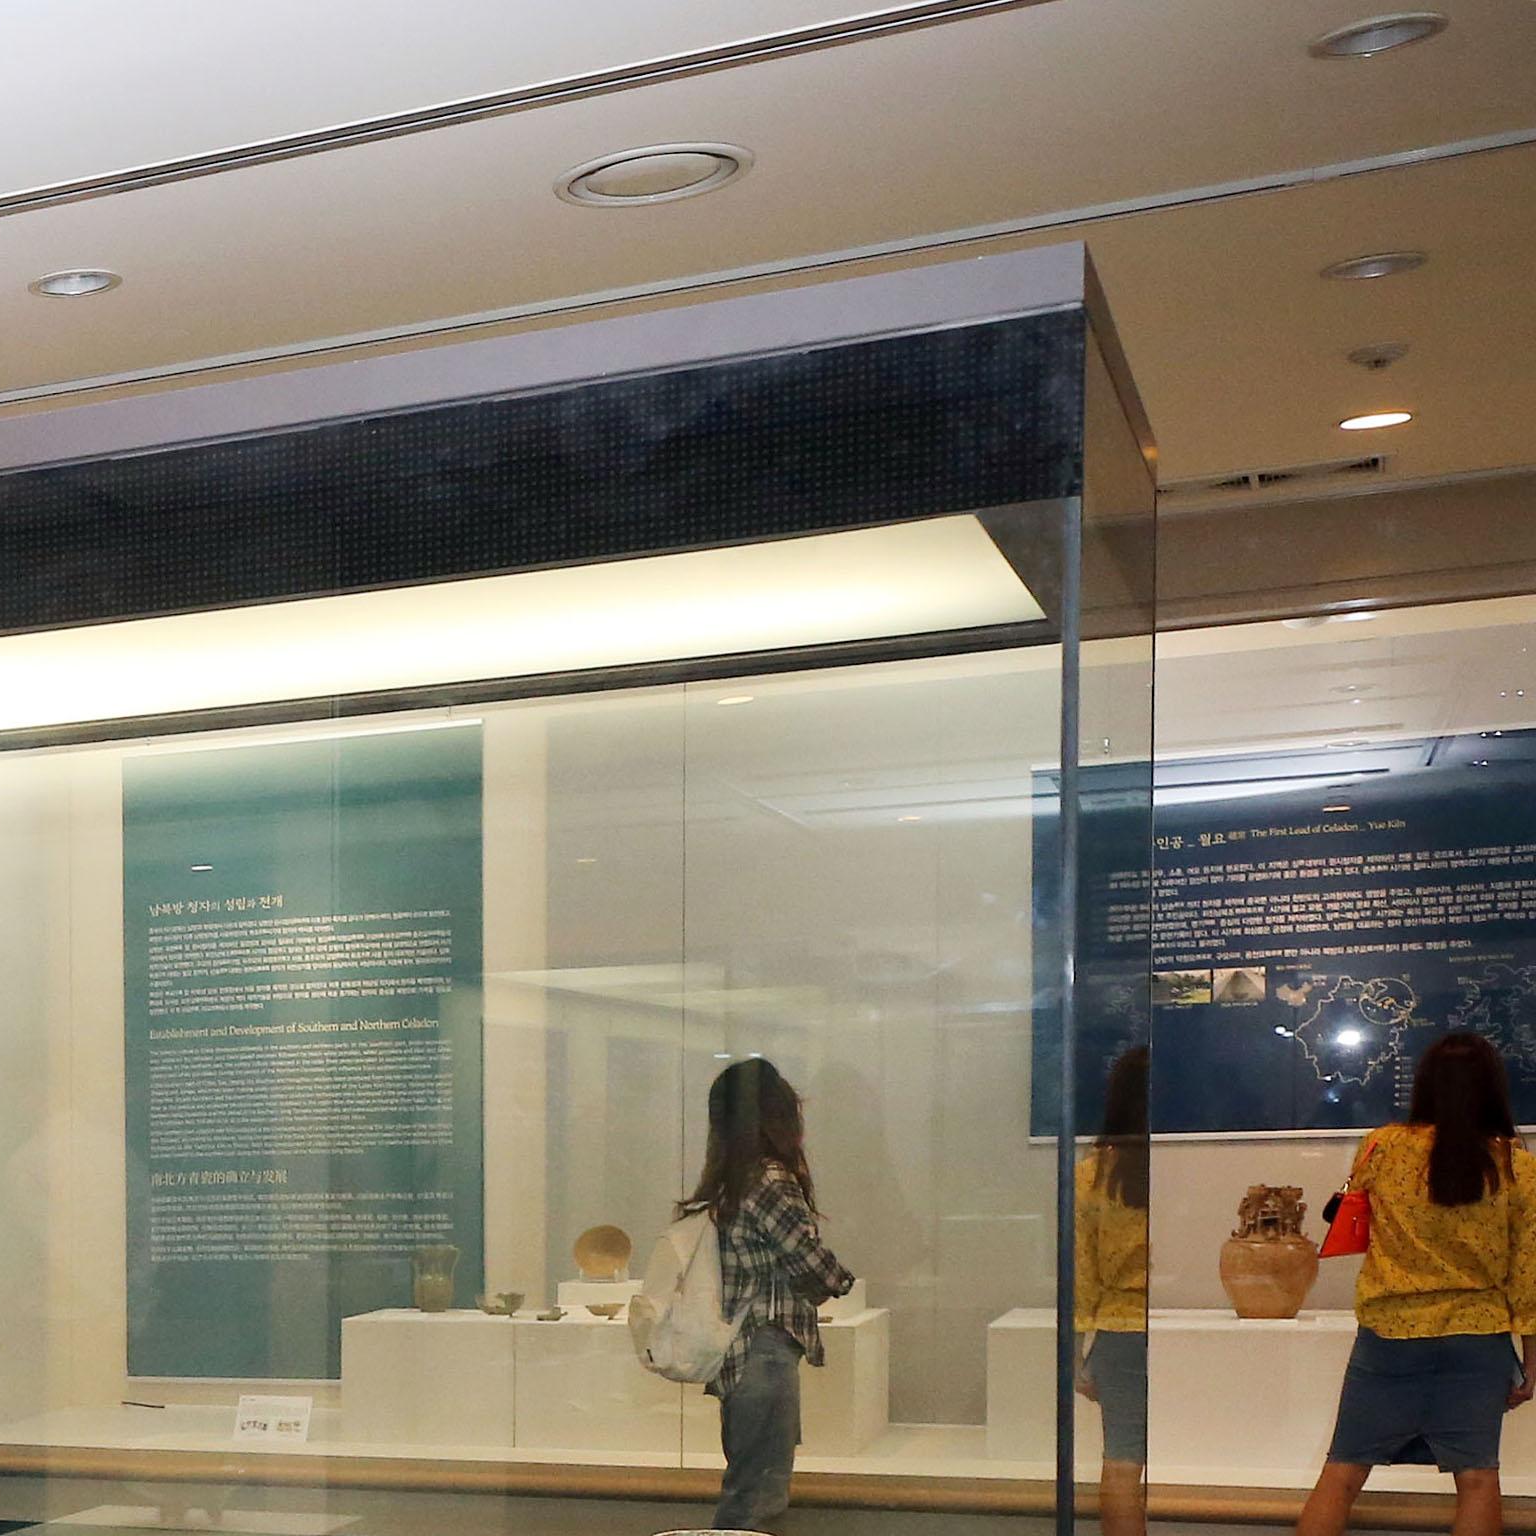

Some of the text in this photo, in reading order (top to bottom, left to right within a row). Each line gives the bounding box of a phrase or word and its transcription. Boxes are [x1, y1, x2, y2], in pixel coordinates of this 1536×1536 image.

[1251, 828, 1268, 838] The
[1269, 827, 1287, 837] First
[1323, 822, 1359, 834] Celadon
[1368, 821, 1386, 831] Yue
[1154, 836, 1184, 850] 인공
[1198, 833, 1227, 848] 월요
[210, 1025, 228, 1037] and
[228, 1023, 285, 1038] Development
[285, 1021, 296, 1034] of
[297, 1020, 339, 1033] Southern
[339, 1020, 358, 1031] and
[359, 1018, 401, 1031] Northern
[402, 1017, 440, 1029] Celadon
